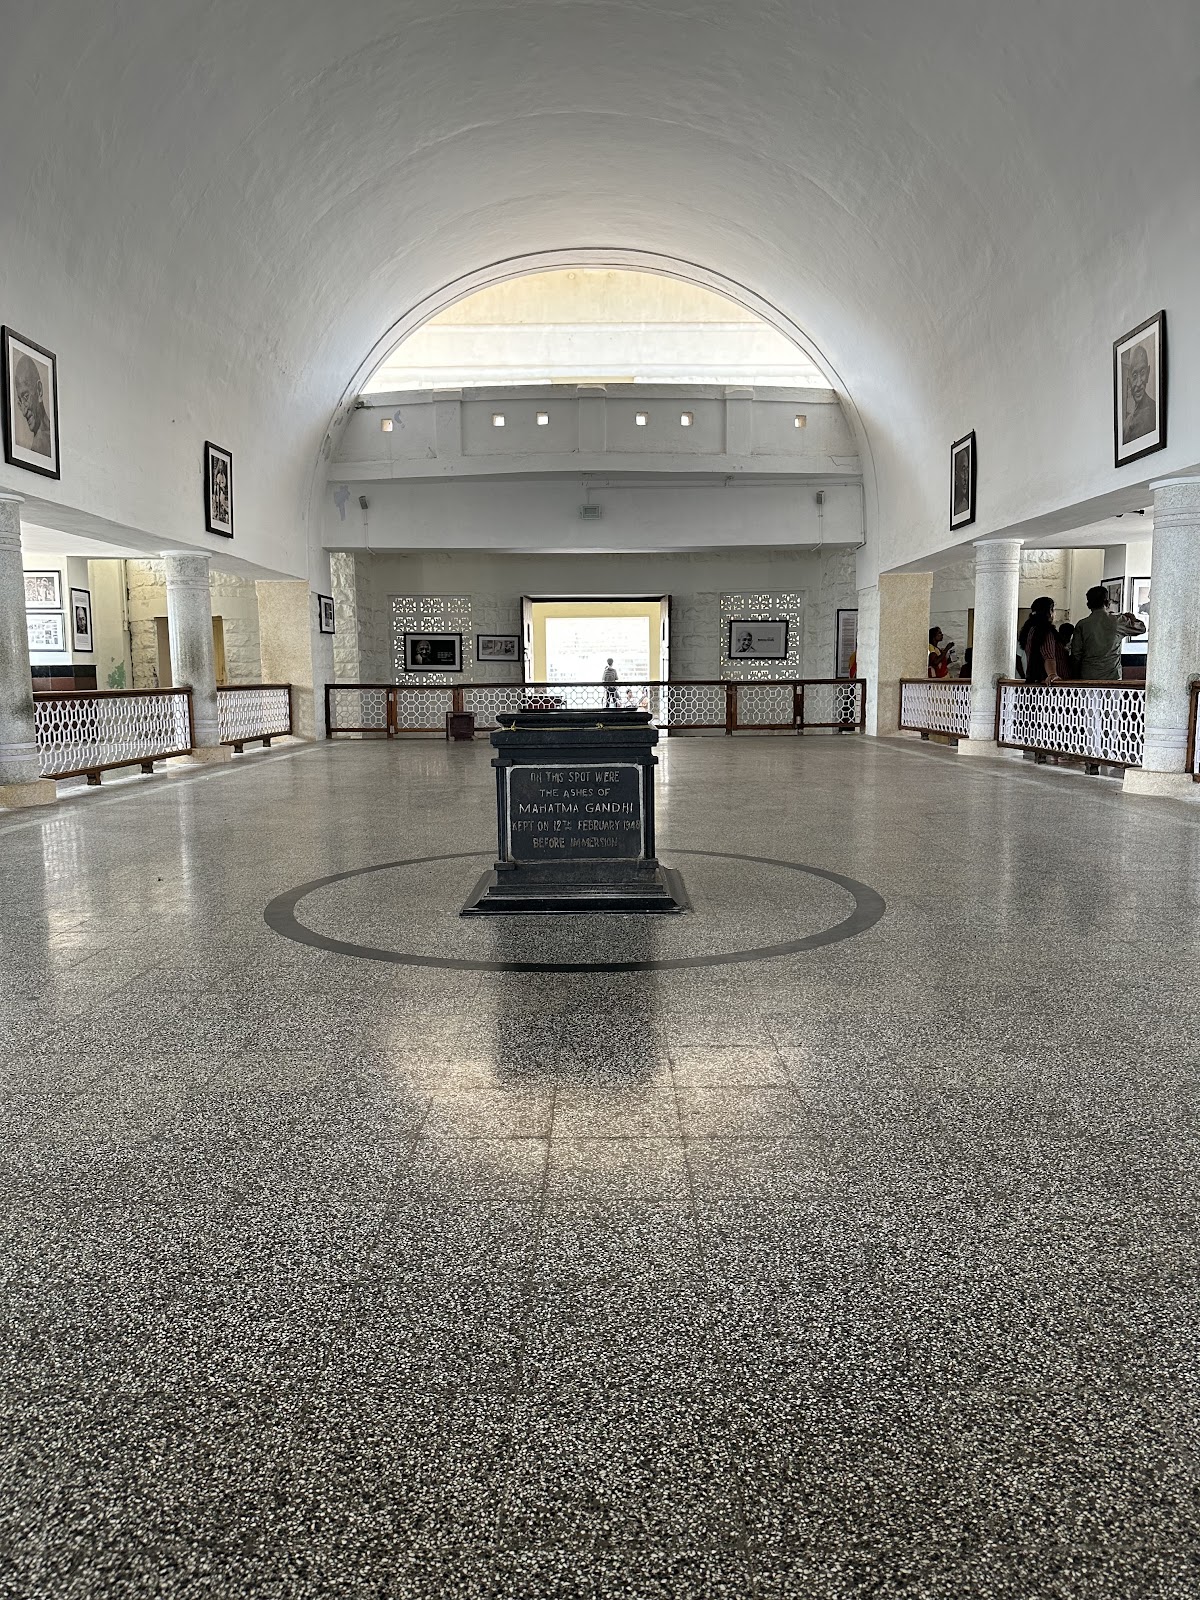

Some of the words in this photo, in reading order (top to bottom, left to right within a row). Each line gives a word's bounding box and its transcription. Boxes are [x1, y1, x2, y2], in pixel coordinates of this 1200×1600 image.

[530, 771, 543, 783] ON
[546, 771, 564, 783] THIS
[568, 771, 591, 783] SPOT
[595, 771, 620, 783] WERE
[539, 788, 559, 798] THE
[563, 788, 593, 799] ASHES
[597, 788, 611, 797] OF
[519, 803, 579, 814] MAHATMA
[585, 803, 634, 814] GANDHI
[512, 820, 534, 831] KEPT
[537, 820, 549, 831] ON
[577, 820, 620, 831] FEBRUARY
[623, 820, 641, 831] 1948
[532, 837, 565, 848] BEFORE
[570, 837, 618, 848] IMMERSION
